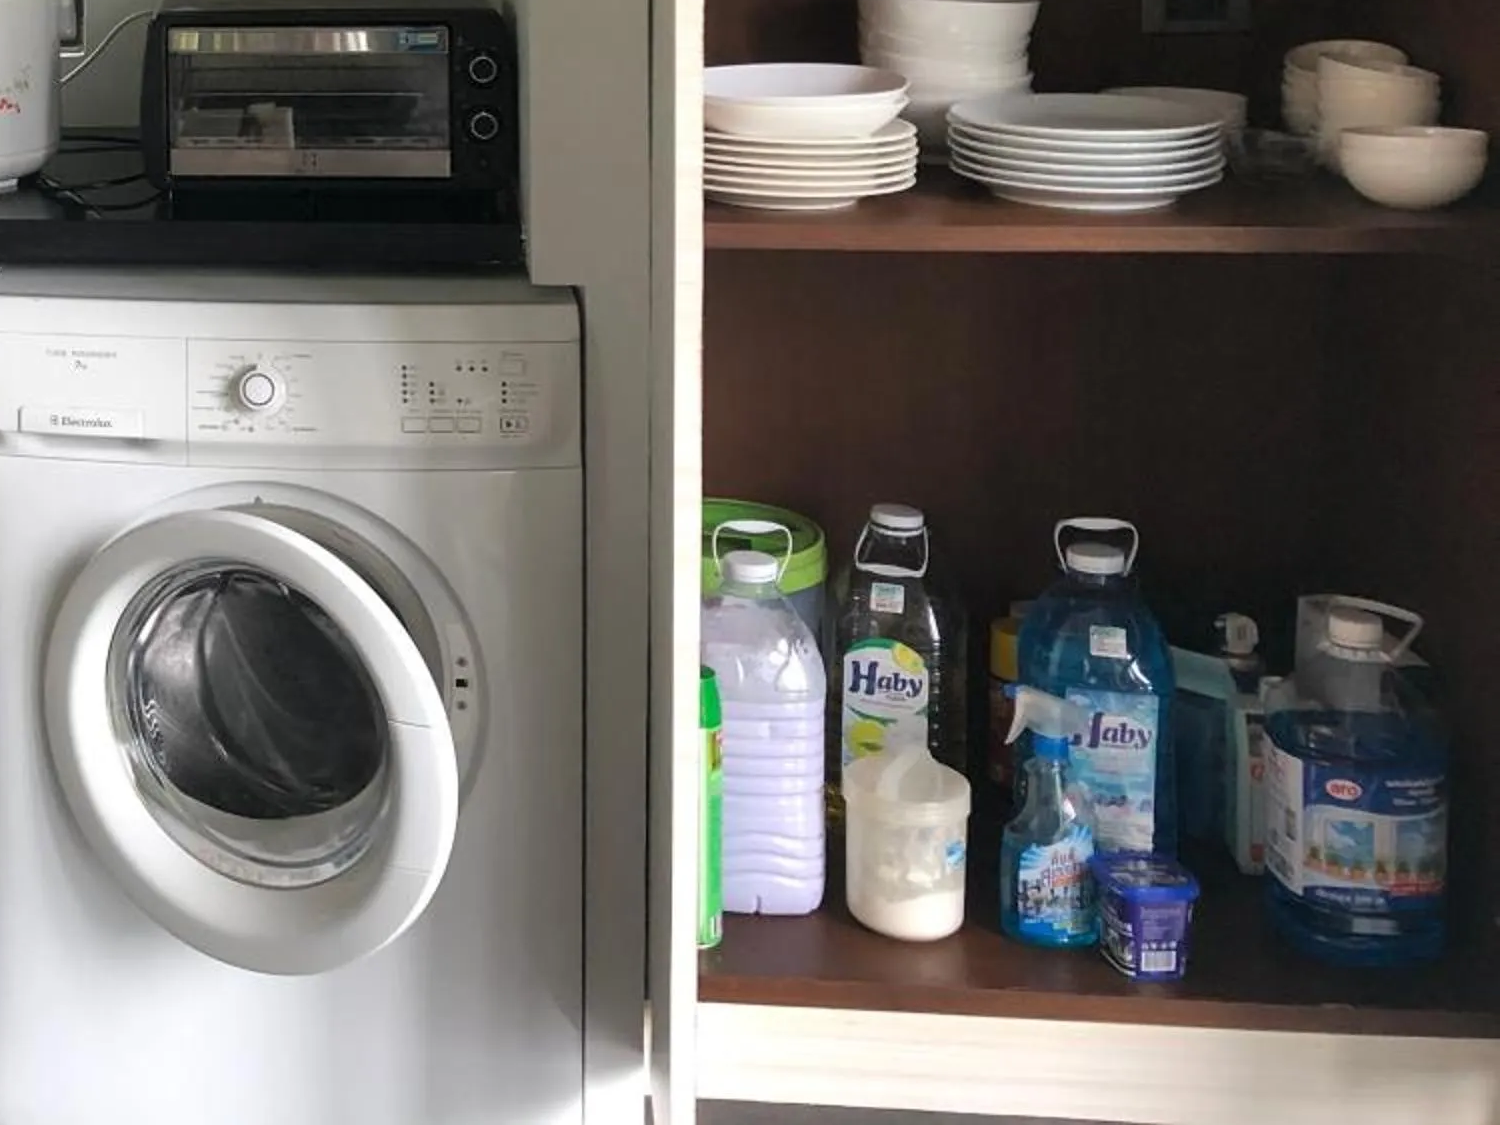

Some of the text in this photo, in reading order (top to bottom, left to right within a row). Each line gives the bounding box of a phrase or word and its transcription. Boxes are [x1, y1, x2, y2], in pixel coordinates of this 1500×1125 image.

[61, 416, 113, 428] Electrolux
[848, 660, 923, 699] Haby
[1329, 782, 1358, 796] aro
